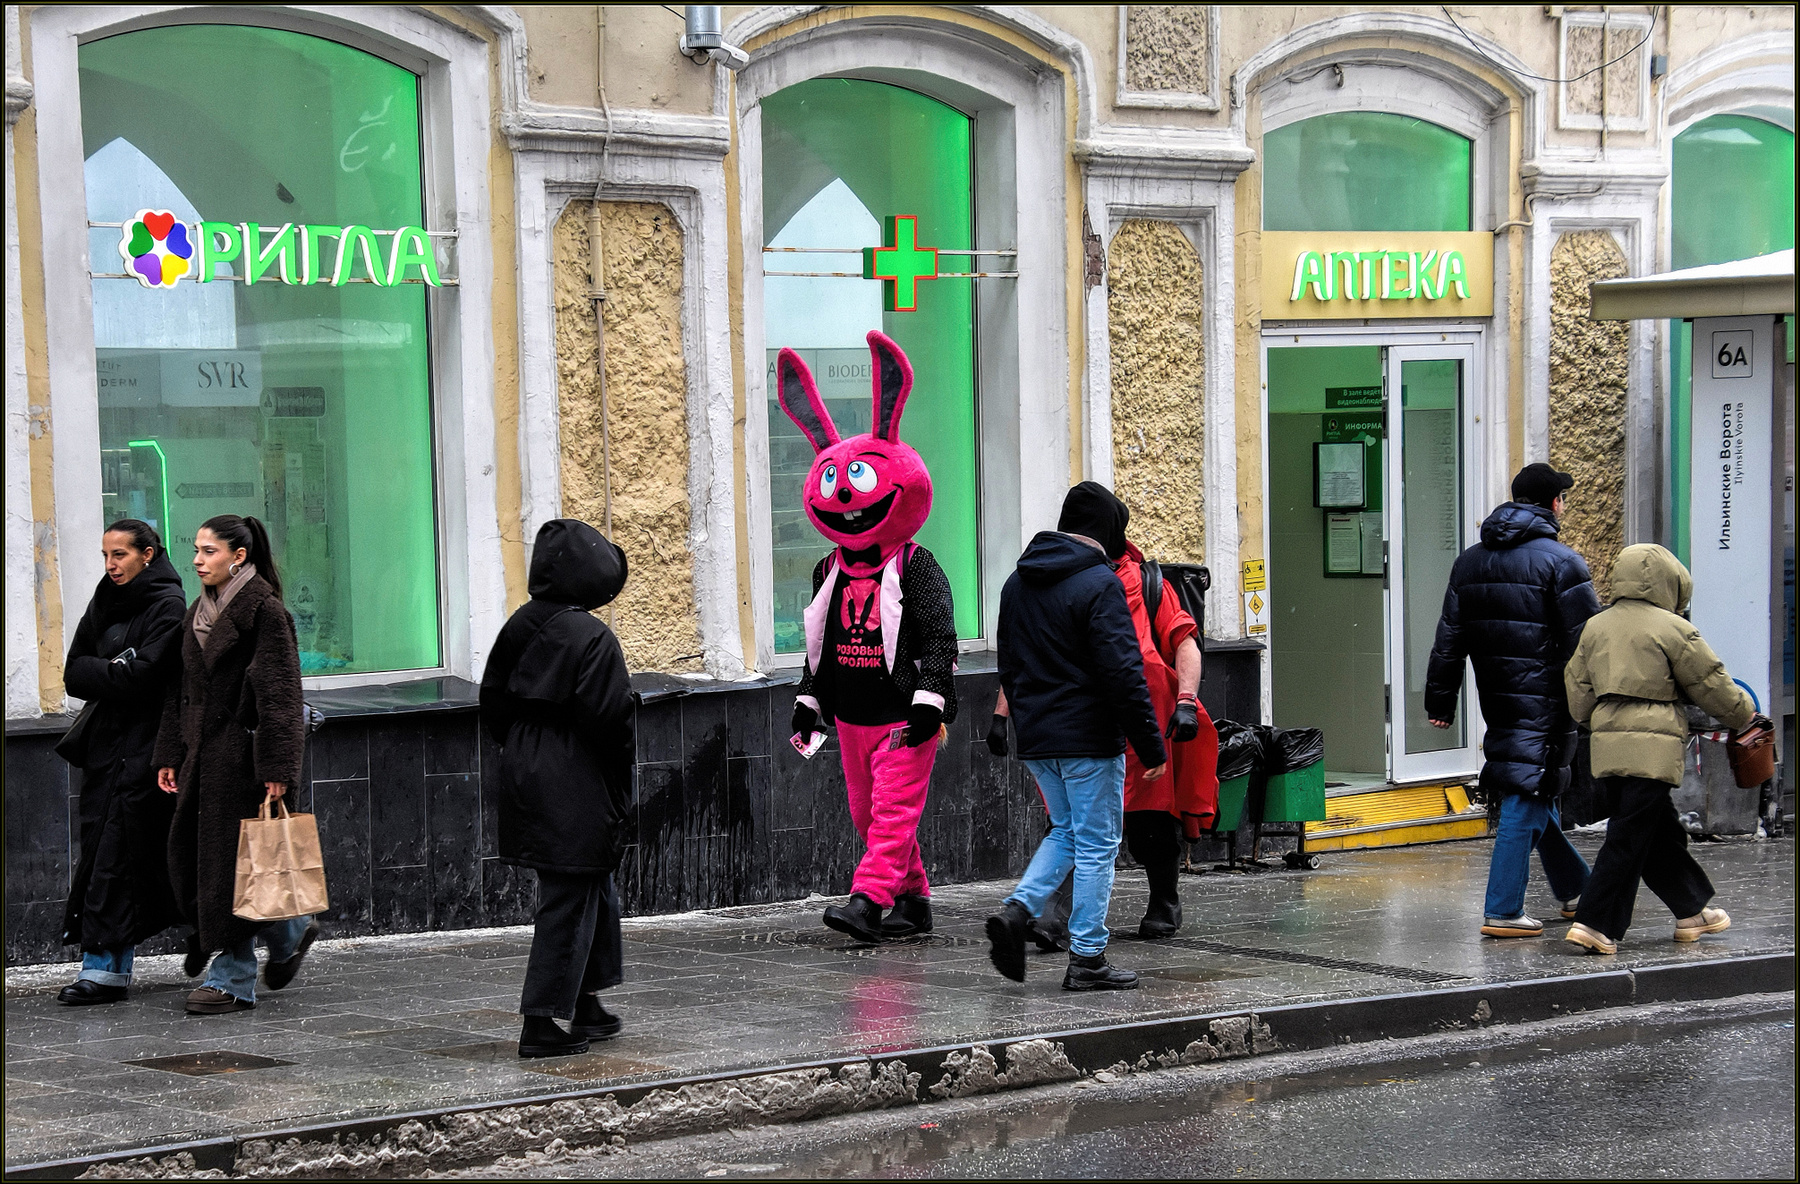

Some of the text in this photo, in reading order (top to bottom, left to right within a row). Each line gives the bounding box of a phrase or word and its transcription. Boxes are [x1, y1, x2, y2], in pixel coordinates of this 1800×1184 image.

[196, 222, 442, 287] РИГЛА
[1290, 250, 1471, 301] АПТЕКА
[1717, 343, 1748, 367] 6А
[197, 361, 249, 389] SVR
[1348, 389, 1362, 397] зале
[1734, 402, 1744, 484] Ilyinskie Vorota
[1719, 403, 1734, 550] Ильинские Ворота
[836, 644, 884, 656] РОЗОВЫЙ
[838, 656, 882, 668] КРОЛИК
